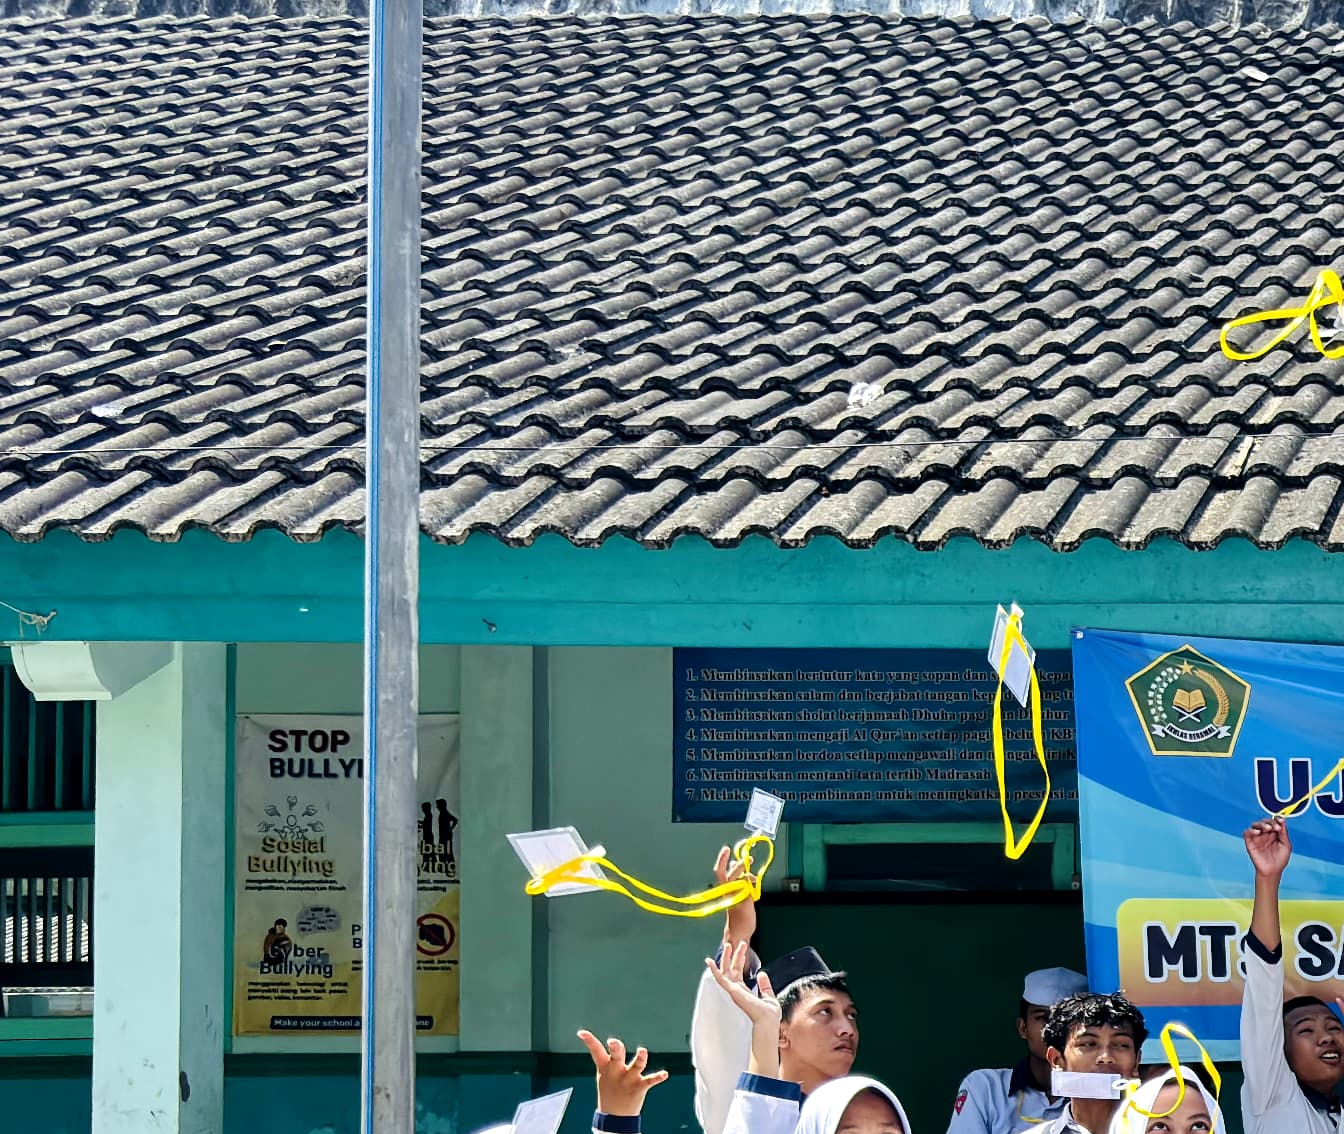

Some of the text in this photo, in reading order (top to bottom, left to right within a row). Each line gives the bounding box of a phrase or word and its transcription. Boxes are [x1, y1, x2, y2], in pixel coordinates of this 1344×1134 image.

[701, 669, 793, 682] Membiasakan
[796, 669, 852, 682] bertutur
[855, 669, 885, 682] kata
[887, 671, 919, 685] yang
[922, 671, 959, 685] sopan
[963, 669, 987, 682] dan
[686, 688, 698, 701] 2.
[700, 688, 793, 701] Membiasakan
[797, 688, 834, 701] salam
[839, 688, 862, 701] dan
[865, 688, 921, 704] berjabat
[925, 690, 969, 704] tangan
[685, 709, 698, 722] 3.
[700, 709, 793, 722] Membiasakan
[797, 709, 835, 722] sholat
[838, 709, 909, 725] berjamaah
[912, 709, 956, 722] Dhuha
[960, 709, 988, 725] pagi
[1018, 708, 1070, 722] Dhur
[268, 729, 350, 753] STOP
[685, 729, 698, 742] 4.
[700, 729, 793, 742] Membiasakan
[797, 729, 849, 744] mengaji
[852, 729, 866, 742] Al
[922, 729, 959, 744] setiap
[963, 729, 991, 744] pagi
[1051, 728, 1076, 741] KB
[701, 749, 793, 761] Membiasakan
[797, 749, 842, 761] berdoa
[846, 749, 883, 764] setiap
[887, 749, 955, 764] mengawali
[959, 749, 983, 761] dan
[269, 758, 364, 778] BULLYI
[686, 769, 991, 782] 6. Membiasakan mentaati tata tertib Madrasah
[685, 788, 697, 801] 7.
[701, 788, 796, 801] Melakskan
[800, 788, 871, 804] pembinaan
[876, 788, 913, 801] untuk
[262, 836, 326, 854] Sosial
[248, 856, 334, 877] Bullying
[417, 857, 457, 878] ying
[260, 961, 333, 978] Bullying
[274, 1019, 298, 1027] Make
[300, 1020, 320, 1028] your
[323, 1019, 353, 1027] school
